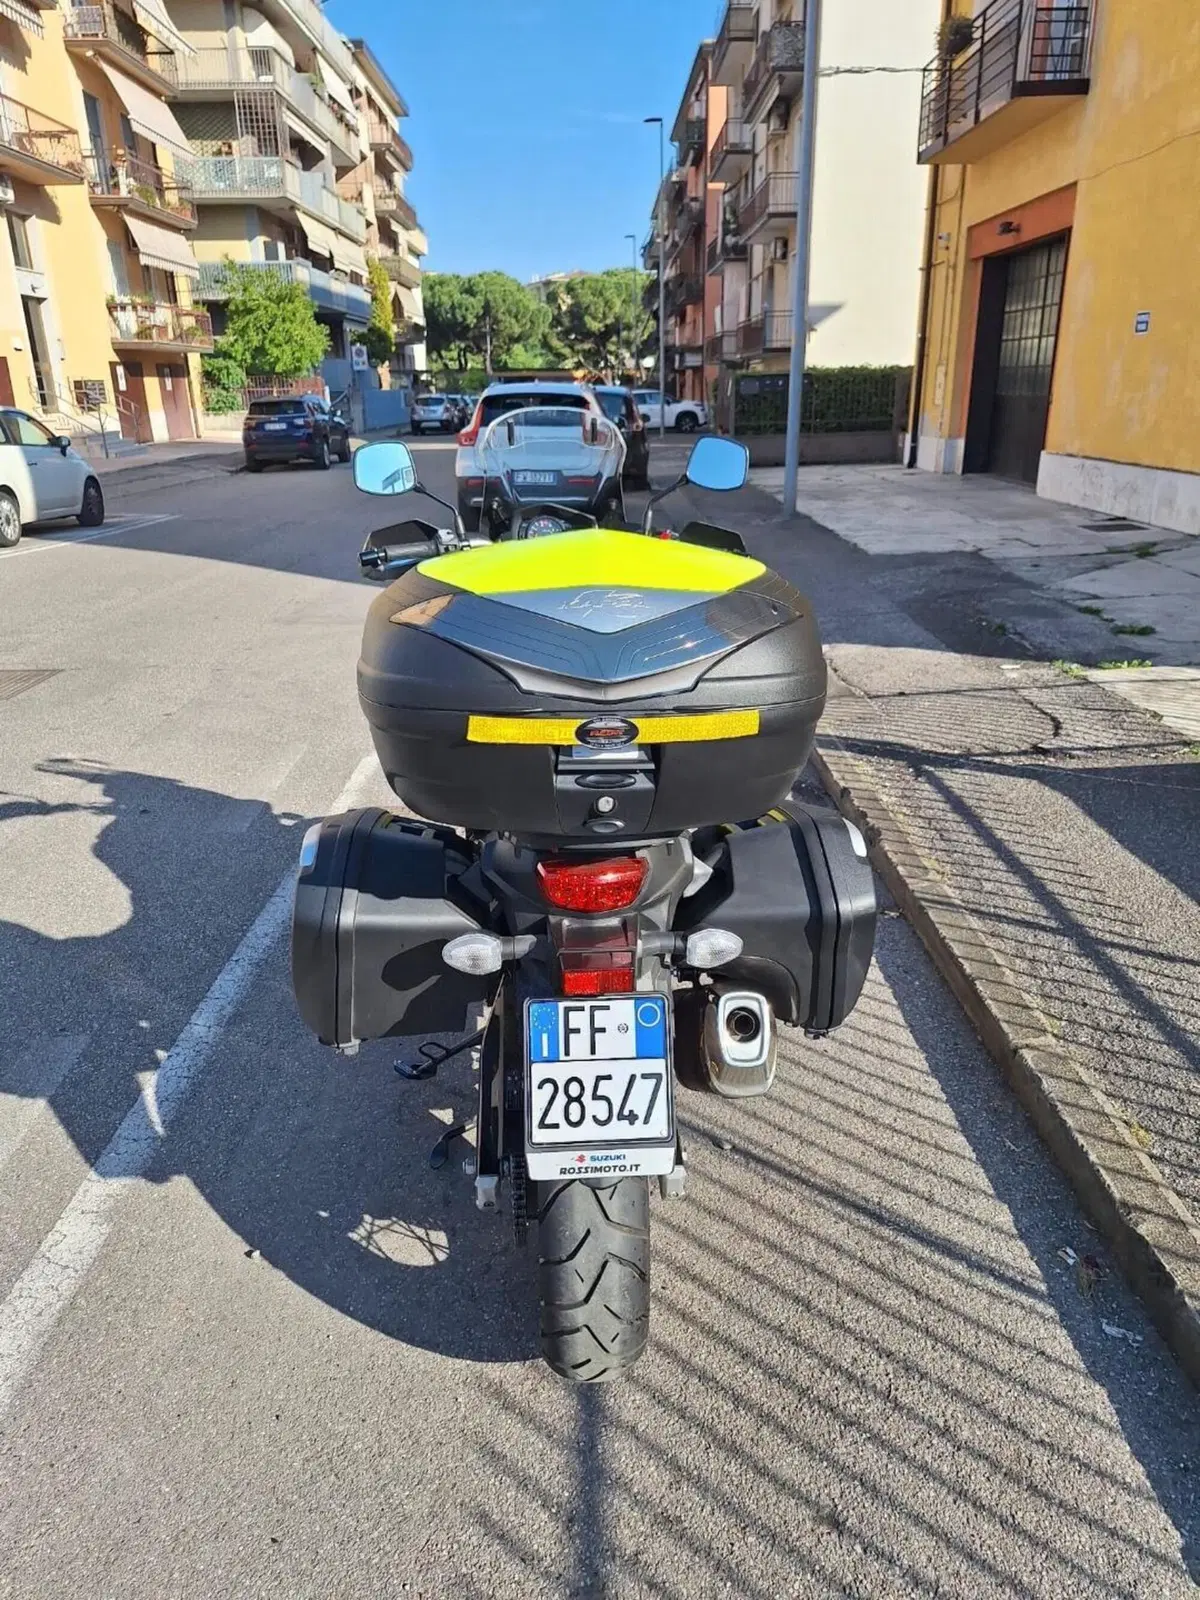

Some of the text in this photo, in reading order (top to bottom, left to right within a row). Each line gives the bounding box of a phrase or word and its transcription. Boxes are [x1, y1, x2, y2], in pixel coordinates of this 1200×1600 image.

[563, 1005, 611, 1057] FF
[541, 1033, 549, 1058] I
[537, 1072, 663, 1130] 28547
[559, 1163, 641, 1176] ROSSIMOTO.IT
[590, 1154, 626, 1162] SUZUKI
